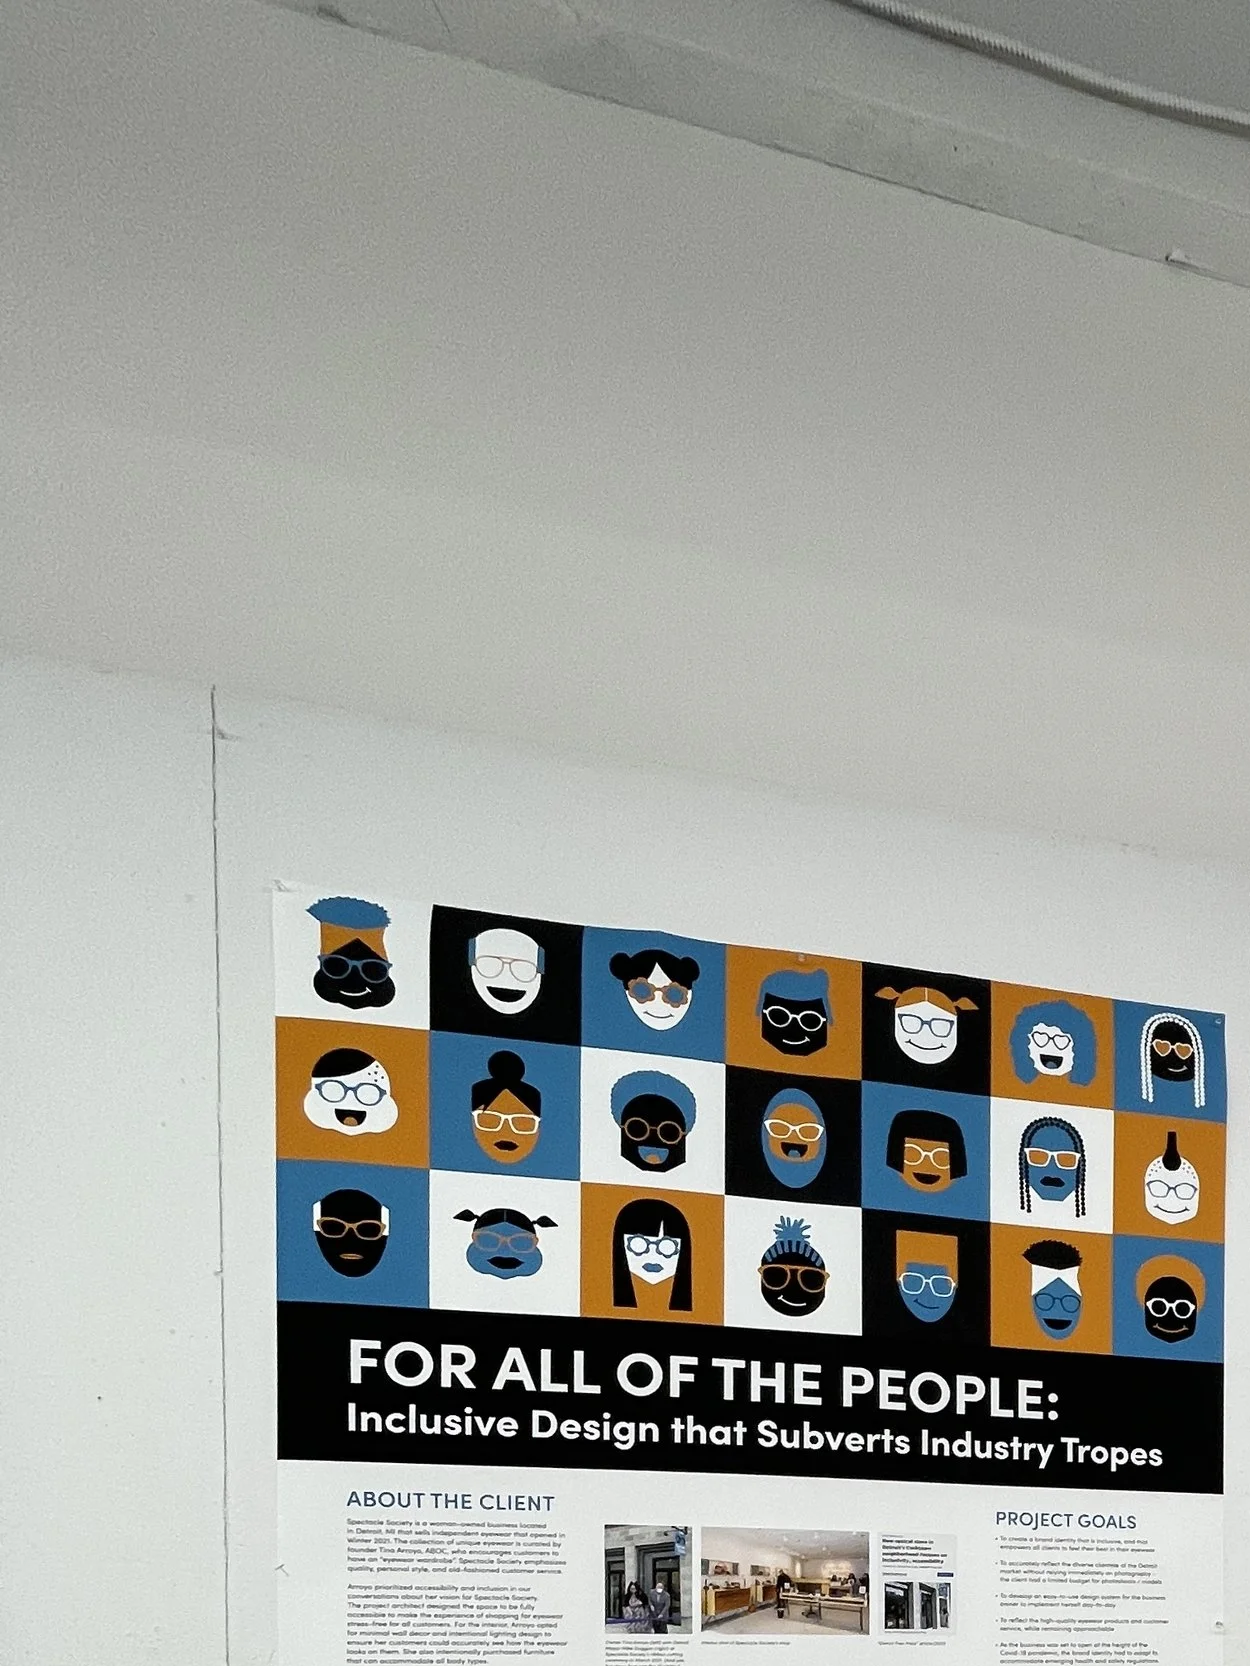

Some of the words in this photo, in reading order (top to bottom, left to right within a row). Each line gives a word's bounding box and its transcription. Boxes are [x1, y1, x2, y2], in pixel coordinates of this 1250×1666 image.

[350, 1340, 476, 1387] FOR
[492, 1348, 601, 1393] ALL
[616, 1353, 698, 1397] OF
[711, 1358, 822, 1404] THE
[842, 1367, 1058, 1418] PEOPLE:
[348, 1403, 518, 1436] Inclusive
[532, 1410, 659, 1449] Design
[670, 1416, 747, 1445] that
[757, 1420, 910, 1453] Subverts
[921, 1430, 1054, 1468] Industry
[1060, 1437, 1162, 1471] Tropes
[346, 1491, 425, 1507] ABOUT
[430, 1493, 472, 1509] THE
[480, 1495, 555, 1510] CLIENT
[996, 1512, 1073, 1530] PROJECT
[1078, 1514, 1136, 1528] GOALS
